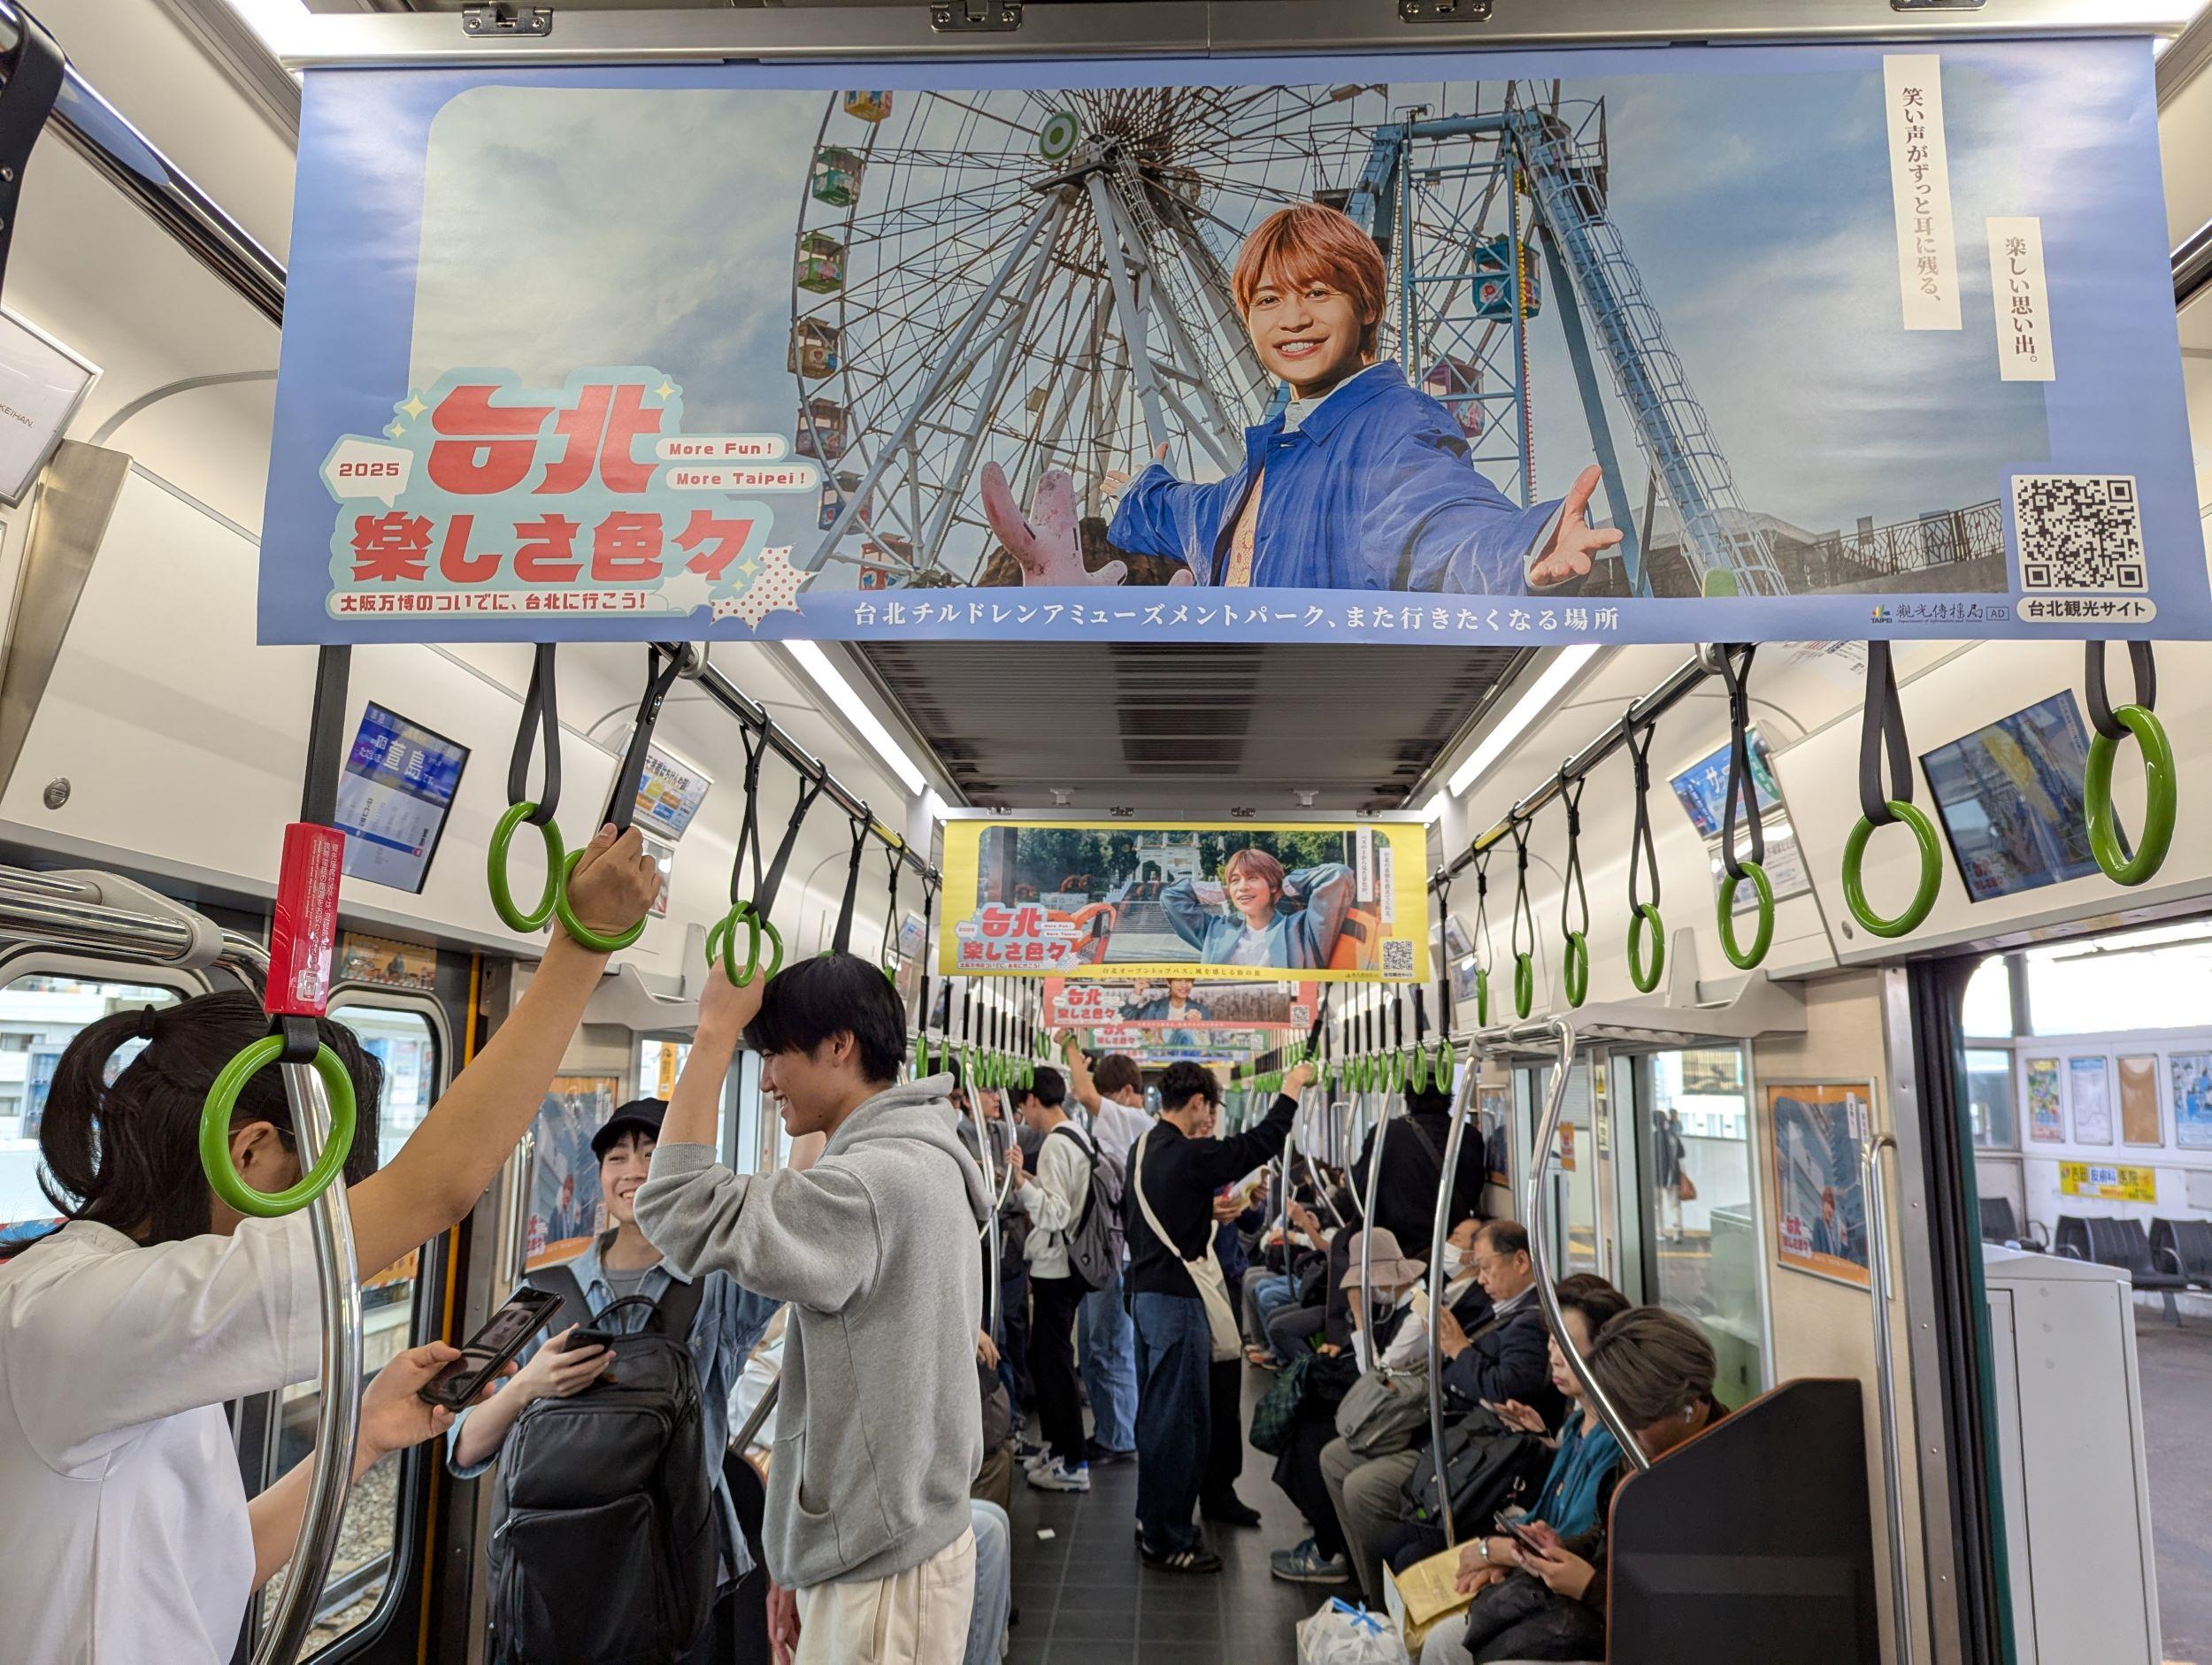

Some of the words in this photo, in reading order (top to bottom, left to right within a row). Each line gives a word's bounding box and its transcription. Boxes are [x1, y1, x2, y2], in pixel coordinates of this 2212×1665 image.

[1901, 87, 1941, 302] 笑い声がずっと耳に残る、
[2005, 236, 2038, 364] 楽しい思い出。
[426, 383, 665, 495] 台北
[669, 441, 714, 457] More
[724, 441, 772, 456] Fun!
[338, 461, 401, 478] 2025
[676, 472, 721, 487] More
[733, 471, 806, 487] Taipei!
[350, 510, 755, 583] 楽しさ色々
[339, 591, 647, 613] 大阪万博のついでに、台北に行こう!
[1991, 609, 2005, 618] AD
[2027, 600, 2147, 618] 台北観光サイト
[853, 601, 1620, 633] 台北チルドレンアミューズメントパーク、また行きたくなる場所
[383, 740, 426, 780] 萱島
[982, 907, 1042, 938] 台北
[963, 940, 1066, 962] 楽しさ色々
